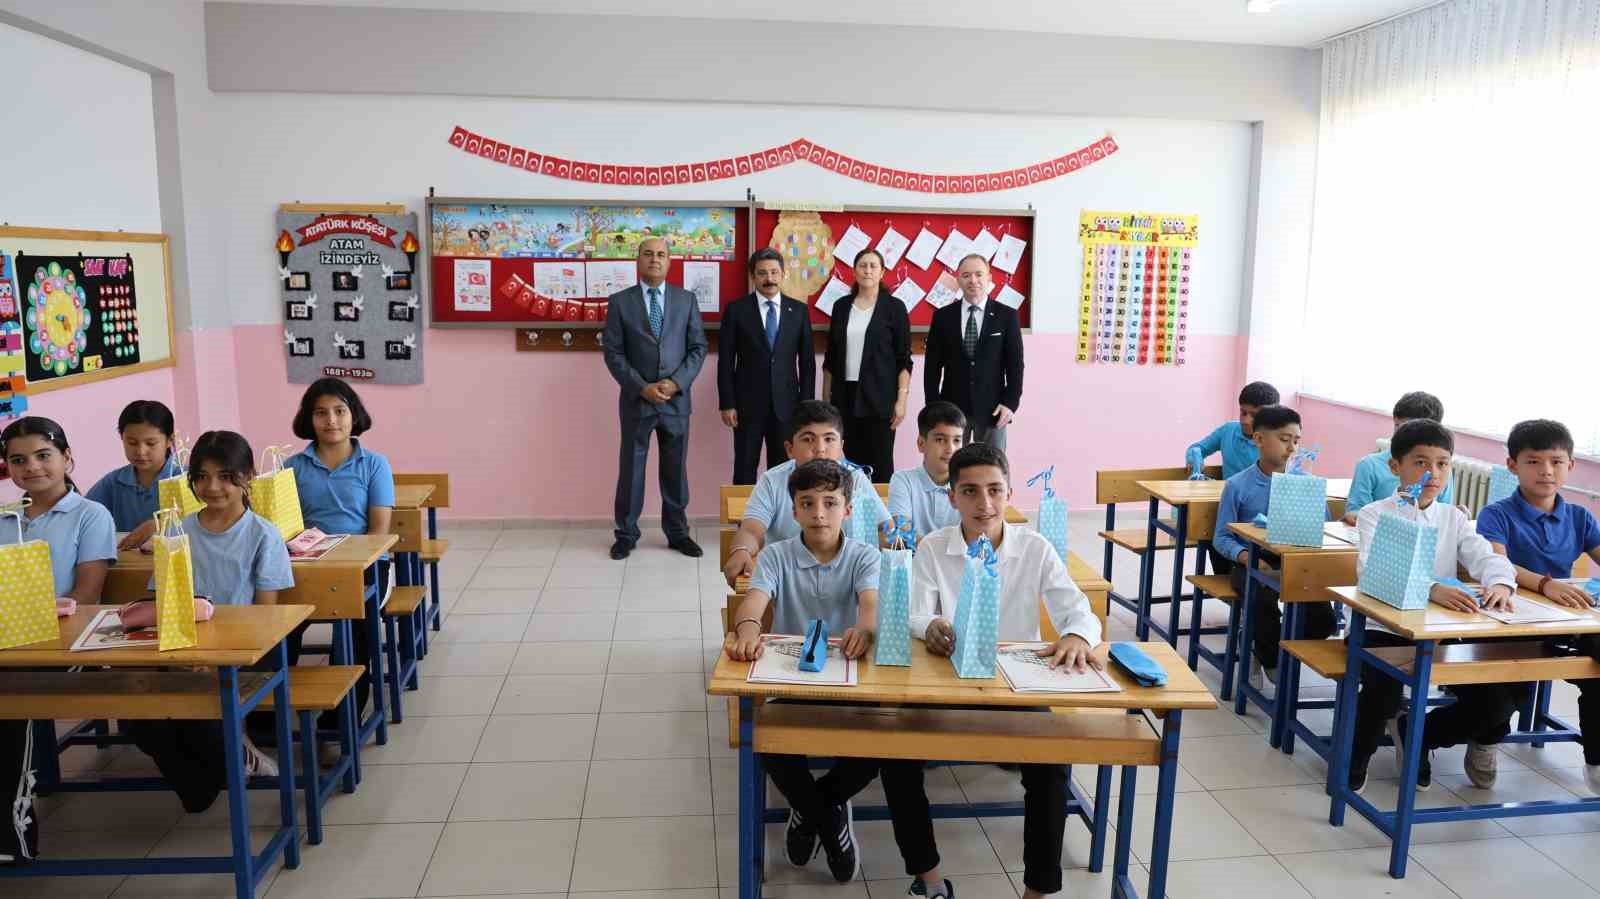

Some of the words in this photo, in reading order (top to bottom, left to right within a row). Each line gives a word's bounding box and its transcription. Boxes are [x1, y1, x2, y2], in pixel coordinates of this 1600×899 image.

[305, 219, 349, 237] ATATÜRK
[352, 218, 388, 237] KÖŞESİ
[330, 239, 364, 249] ATAM
[320, 251, 380, 264] İZİNDEYİZ
